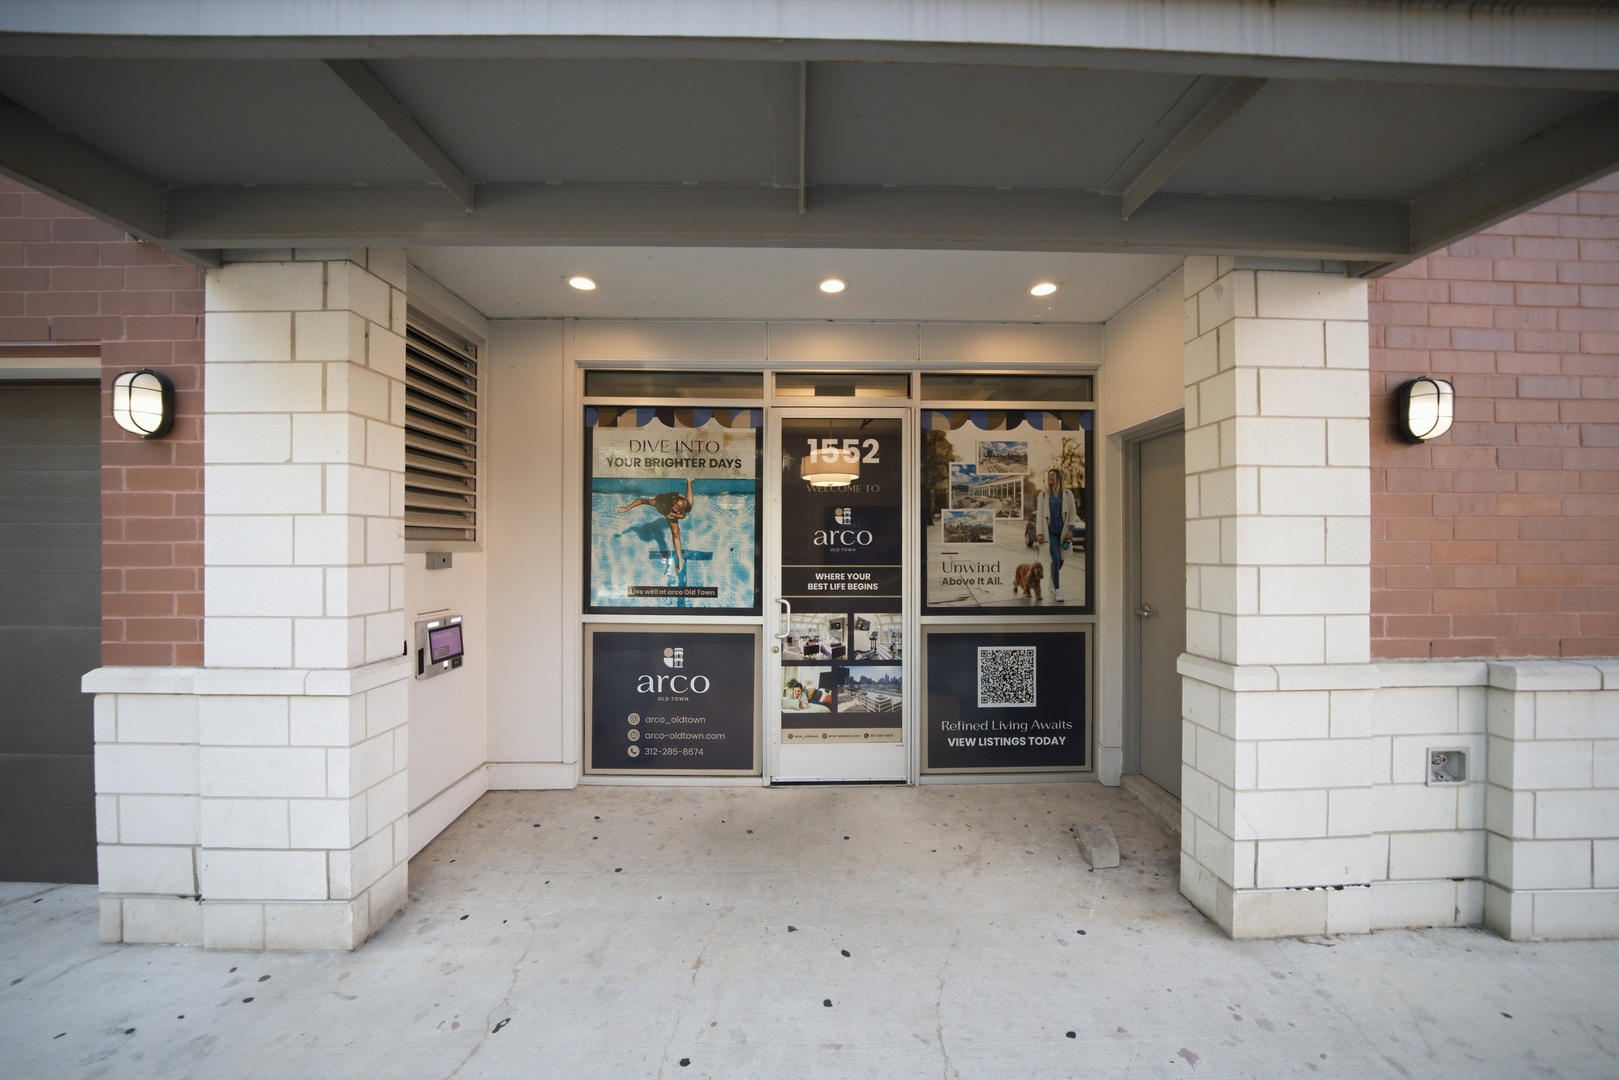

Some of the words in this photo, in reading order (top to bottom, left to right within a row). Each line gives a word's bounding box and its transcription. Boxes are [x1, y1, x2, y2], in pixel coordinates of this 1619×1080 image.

[629, 440, 670, 453] DIVE
[675, 440, 720, 454] INTO
[807, 438, 880, 464] 1552
[607, 457, 641, 468] YOUR
[645, 458, 706, 468] BRIGHTER
[709, 458, 742, 469] DAYS
[806, 484, 862, 493] WELCOME
[865, 484, 880, 493] TO
[813, 529, 873, 546] arco
[942, 560, 1000, 574] Unwind
[815, 572, 846, 581] WHERE
[847, 572, 871, 581] YOUR
[942, 576, 975, 586] Above
[977, 576, 985, 586] It
[987, 576, 1003, 586] All.
[644, 587, 658, 595] well
[659, 588, 667, 596] at
[684, 588, 696, 596] Old
[807, 583, 829, 591] BEST
[830, 583, 847, 591] LIFE
[847, 583, 879, 591] BEGINS
[637, 674, 710, 693] arco
[644, 715, 706, 725] arco_oldtown
[941, 720, 988, 731] Refined
[991, 719, 1028, 732] Living
[1031, 719, 1073, 730] Awaits
[645, 732, 725, 740] arco-oldtown.com
[947, 737, 977, 747] VIEW
[978, 736, 1027, 747] LISTINGS
[1028, 736, 1067, 746] TODAY
[644, 747, 704, 756] 312-285-8674
